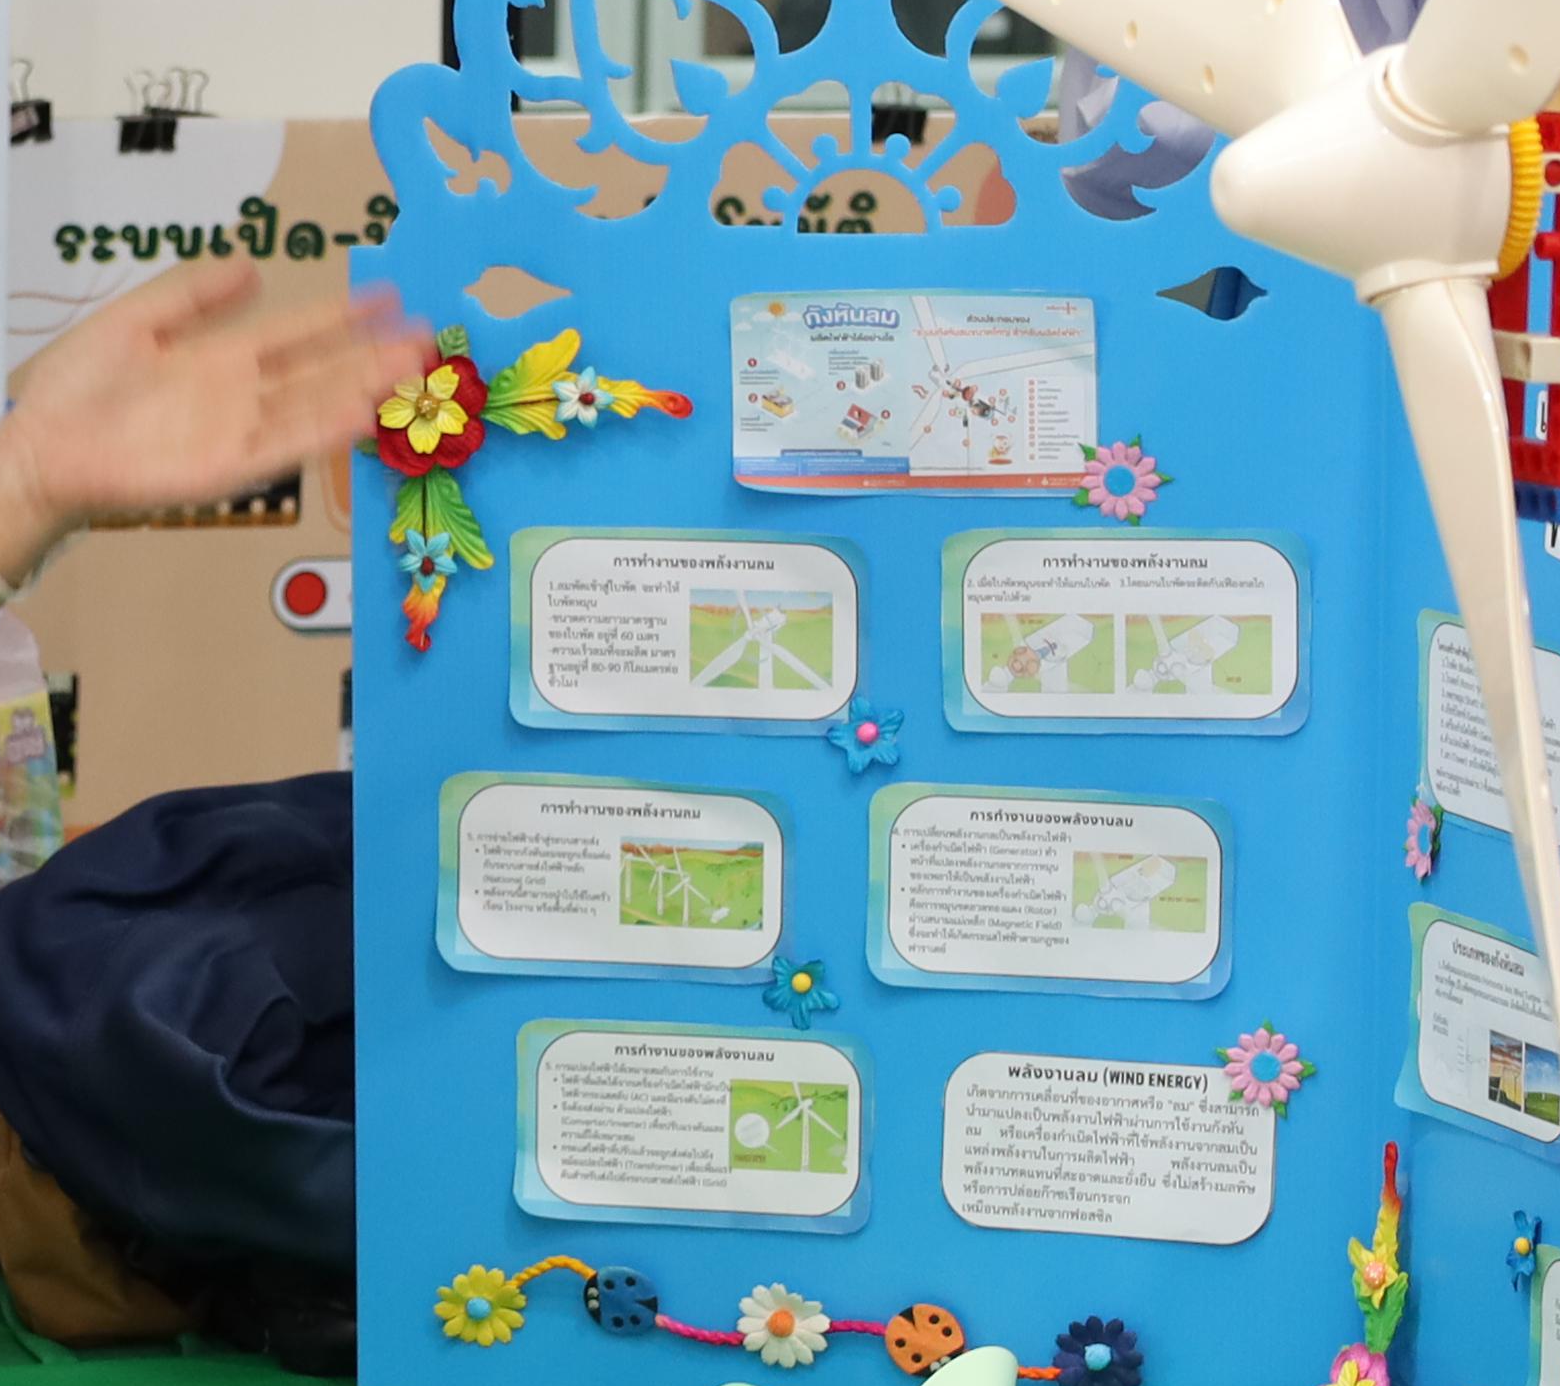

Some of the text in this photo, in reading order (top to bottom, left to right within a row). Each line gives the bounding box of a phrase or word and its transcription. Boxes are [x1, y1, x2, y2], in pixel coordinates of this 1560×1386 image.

[803, 302, 899, 330] กังหันลม
[613, 553, 775, 572] การทำงานของพลังงานลม
[1042, 553, 1208, 571] การทำงานของพลังงานลม
[1007, 1063, 1209, 1093] พลังงานลม (WIND ENERGY)
